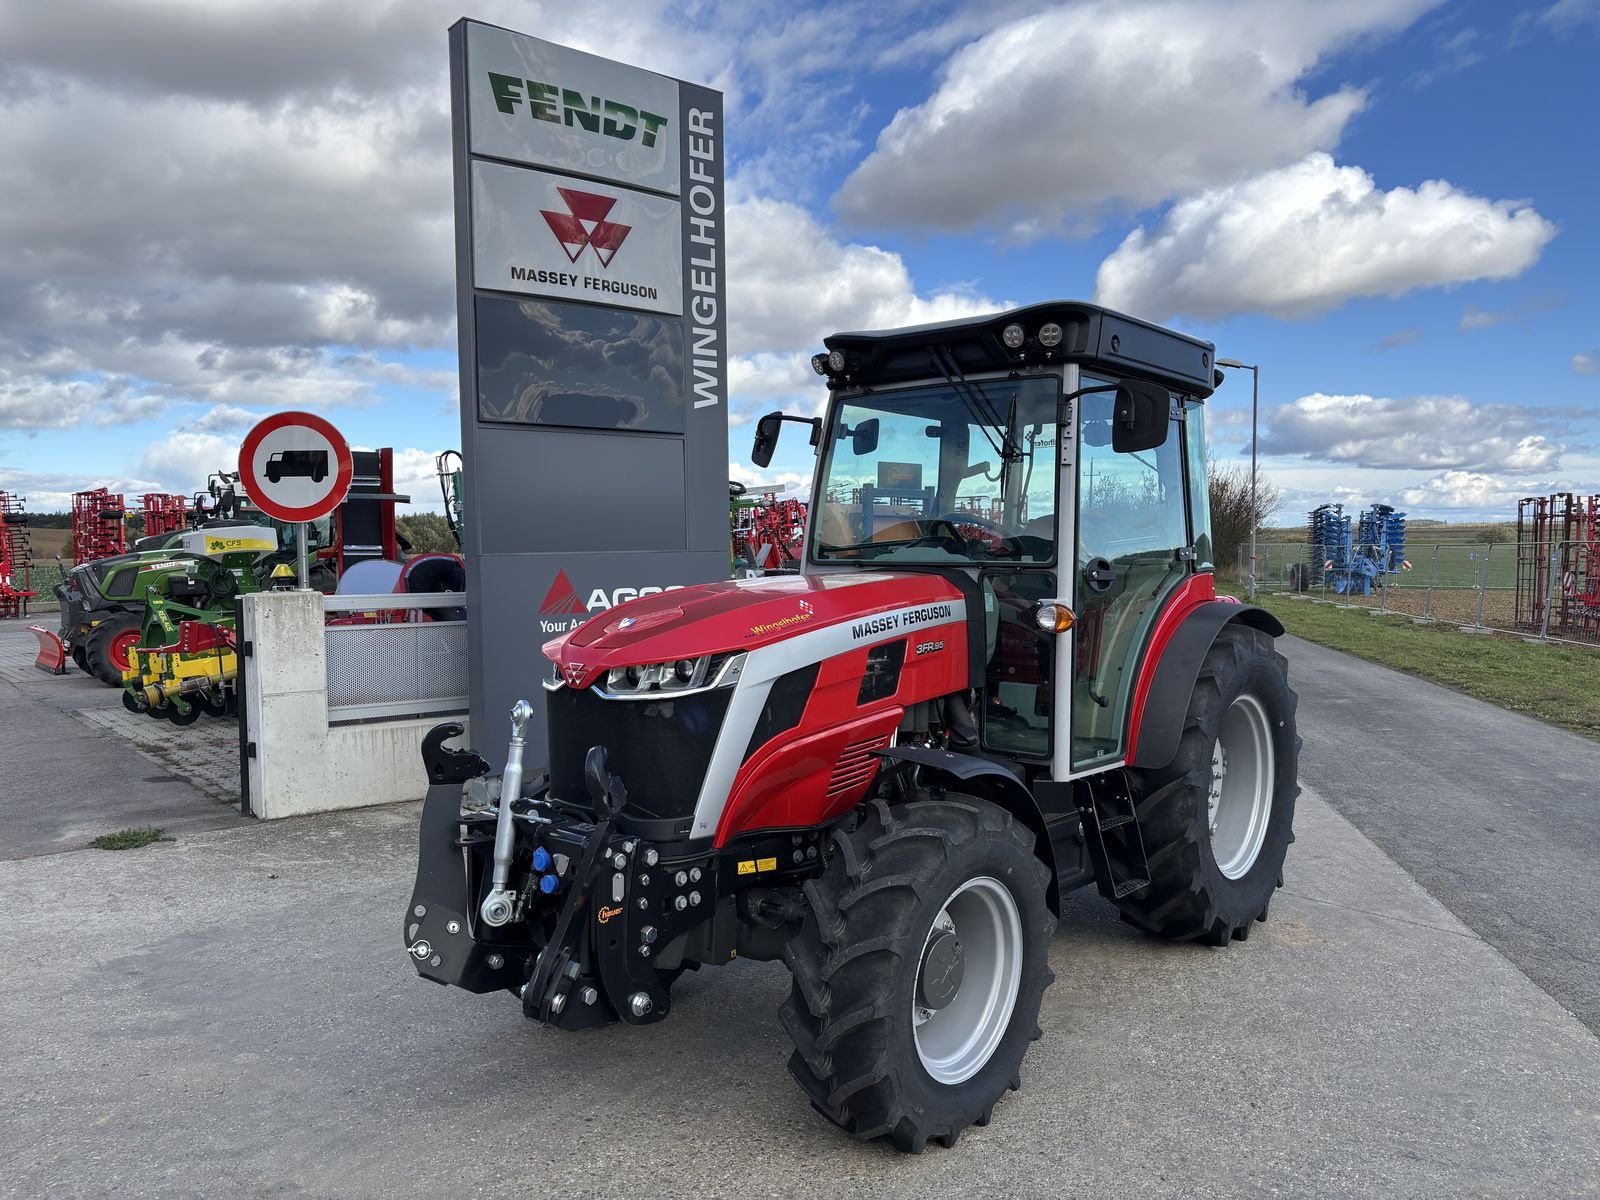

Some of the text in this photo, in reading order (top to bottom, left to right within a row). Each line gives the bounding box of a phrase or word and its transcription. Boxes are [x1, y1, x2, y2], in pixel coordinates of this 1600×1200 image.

[488, 72, 668, 148] FENDT
[688, 107, 719, 409] WINGELHOFER
[511, 266, 658, 300] MASSEY FERGUSON
[226, 539, 242, 547] CFS
[586, 586, 686, 612] AG
[540, 619, 567, 632] Your
[852, 605, 951, 639] MASSEY FERGUSON
[916, 640, 944, 655] 3FR.95
